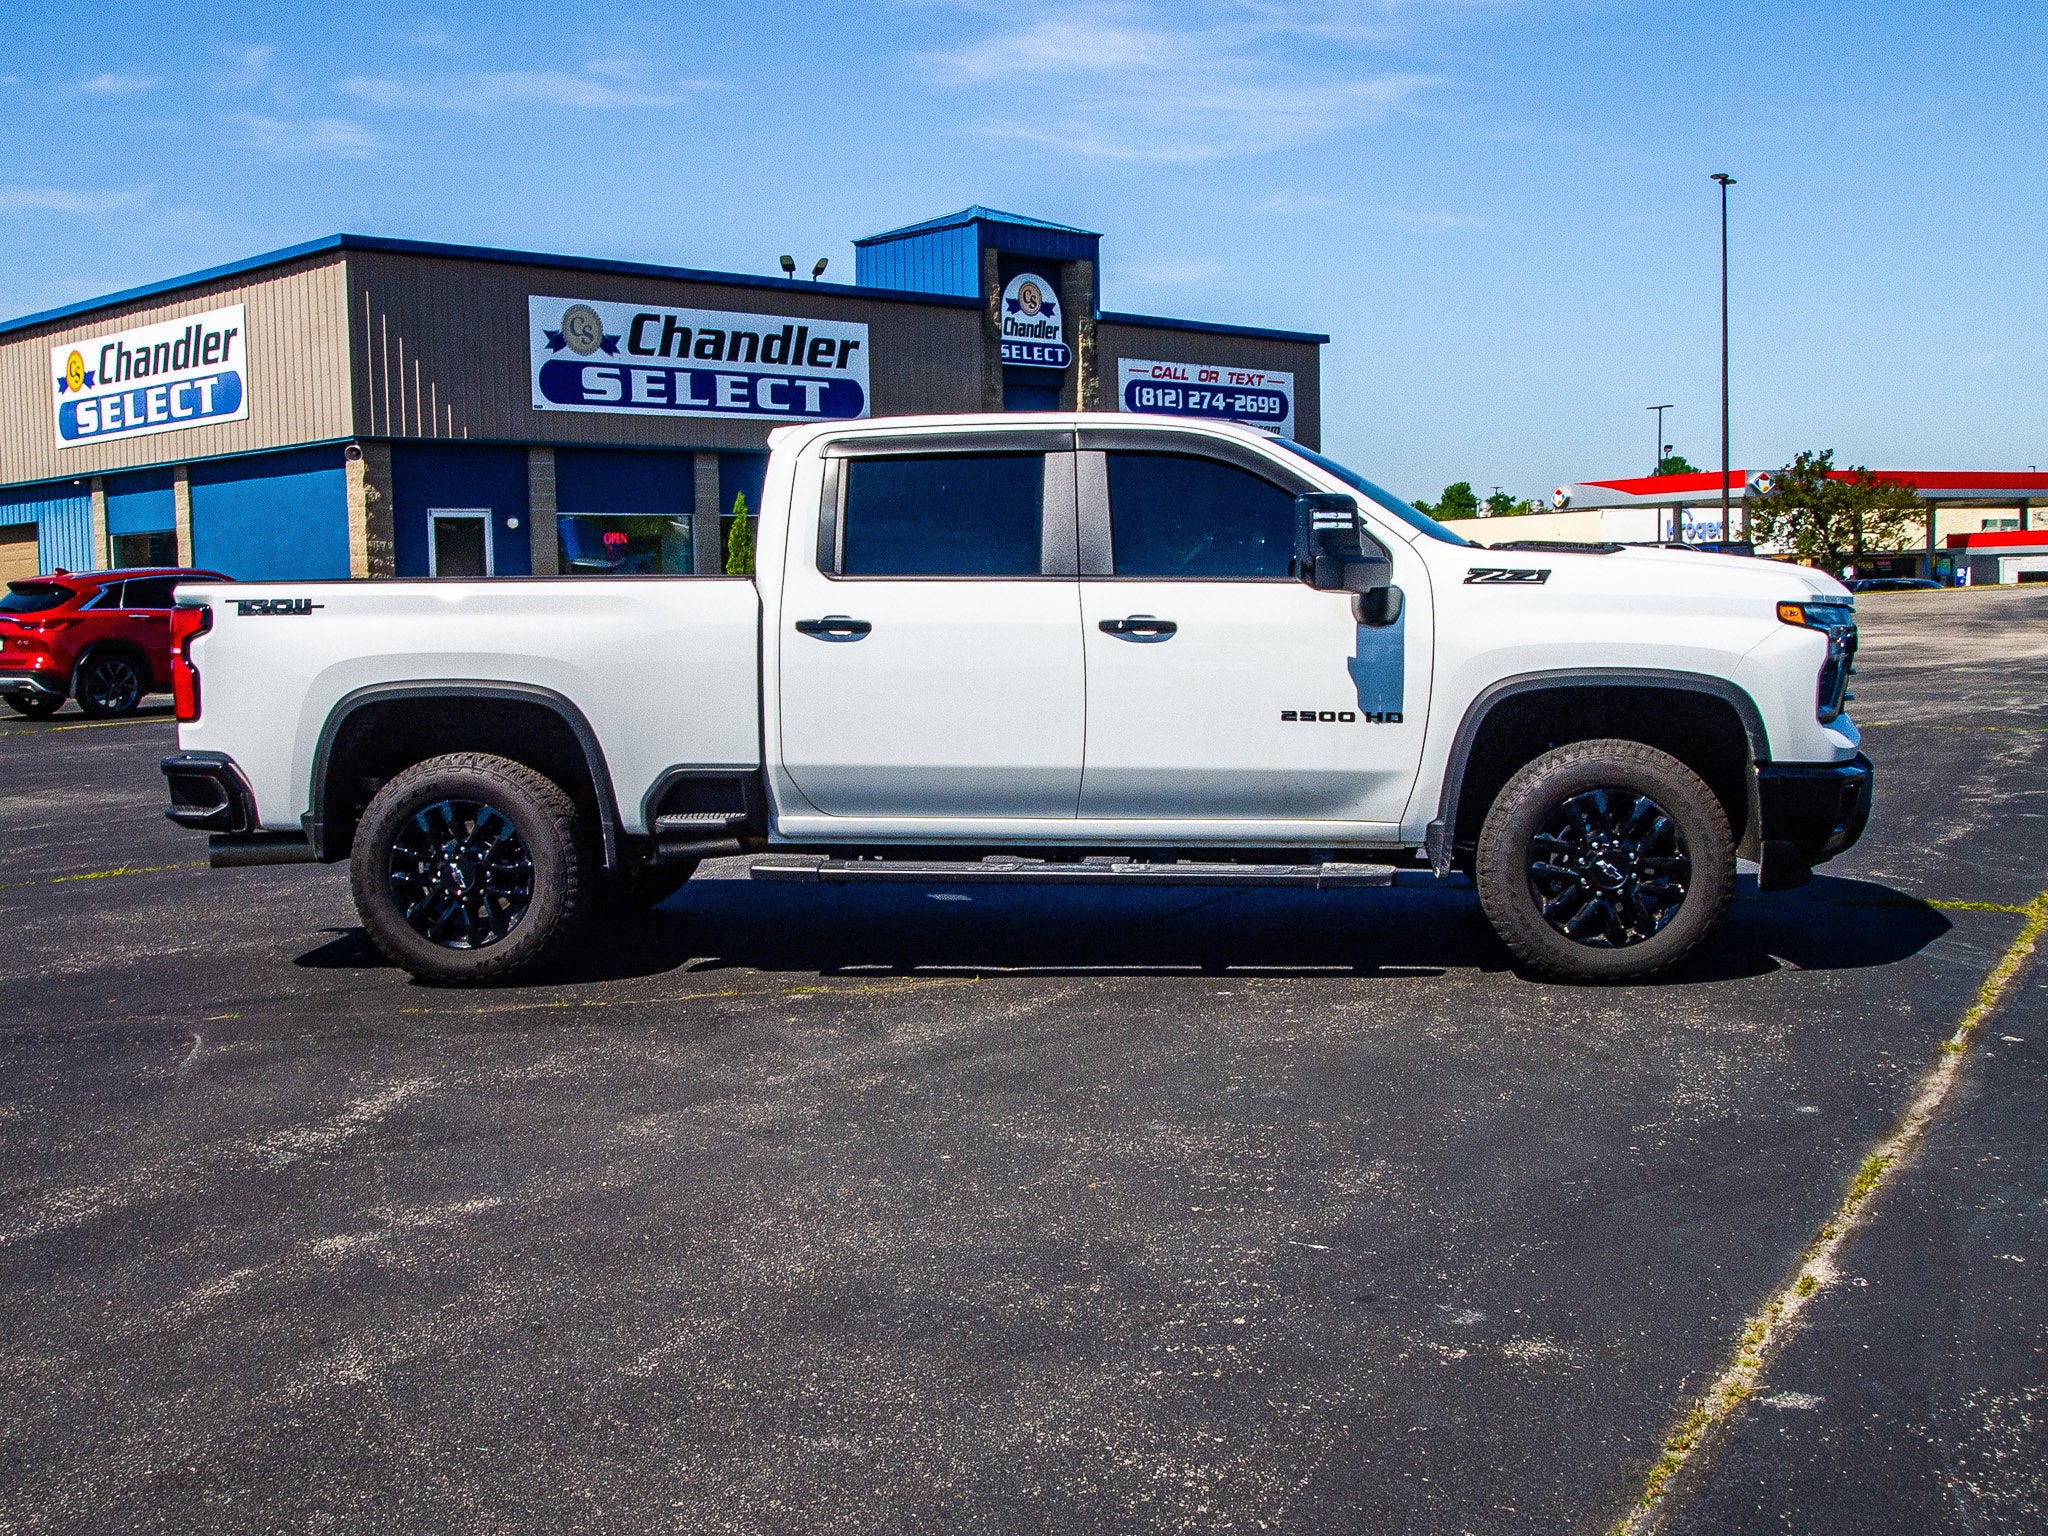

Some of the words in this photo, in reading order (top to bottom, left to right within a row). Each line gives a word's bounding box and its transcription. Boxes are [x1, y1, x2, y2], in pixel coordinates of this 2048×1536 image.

[1023, 289, 1038, 309] CS
[569, 316, 594, 345] CS
[627, 312, 861, 370] Chandler
[1003, 316, 1060, 340] Chandler
[98, 323, 238, 385] Chandler
[1001, 343, 1065, 363] SELECT
[1151, 365, 1189, 381] CALL
[1197, 369, 1220, 383] OR
[1227, 371, 1266, 387] TEXT
[580, 366, 831, 413] SELECT
[1134, 386, 1183, 410] (812)
[1188, 390, 1280, 415] 274-2699
[75, 376, 220, 436] SELECT
[603, 531, 628, 545] OPEN
[1280, 710, 1356, 723] 2500
[1365, 711, 1404, 724] HD
